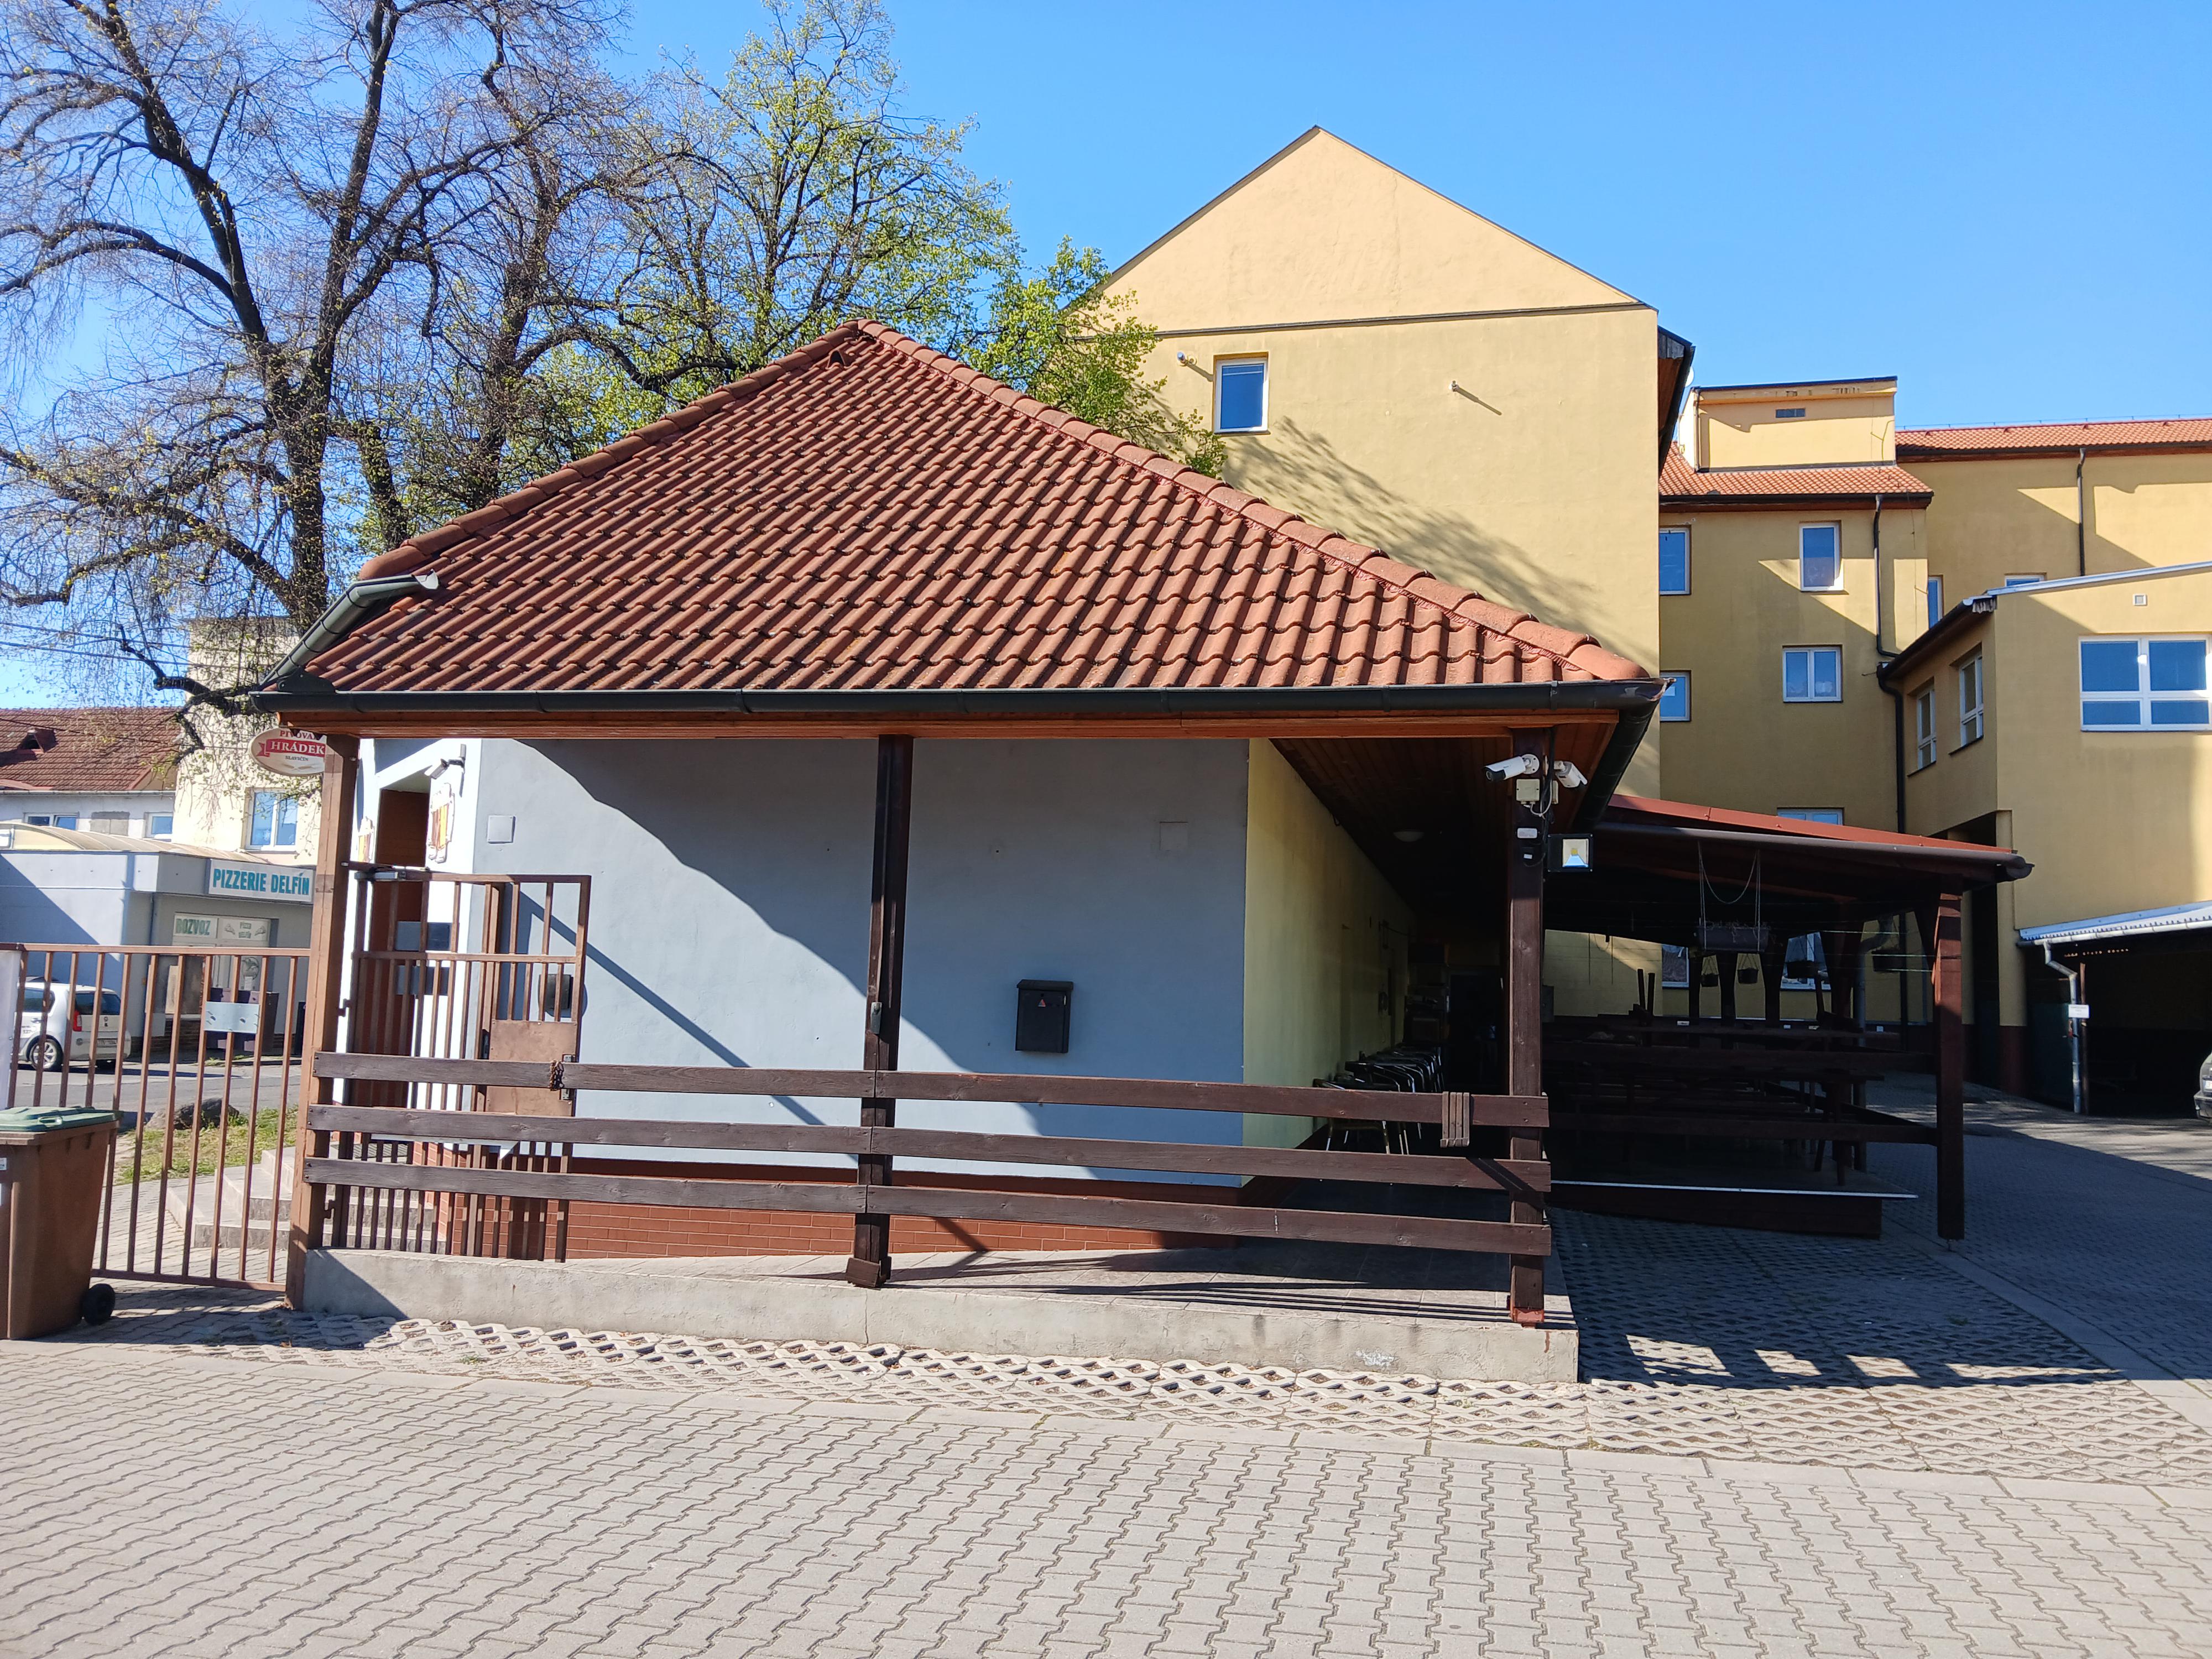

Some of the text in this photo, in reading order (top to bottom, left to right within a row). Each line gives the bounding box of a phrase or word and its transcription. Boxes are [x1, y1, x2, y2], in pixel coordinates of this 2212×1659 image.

[271, 741, 325, 754] HRÁDEK
[213, 868, 310, 895] PIZZERIE DELFÍN
